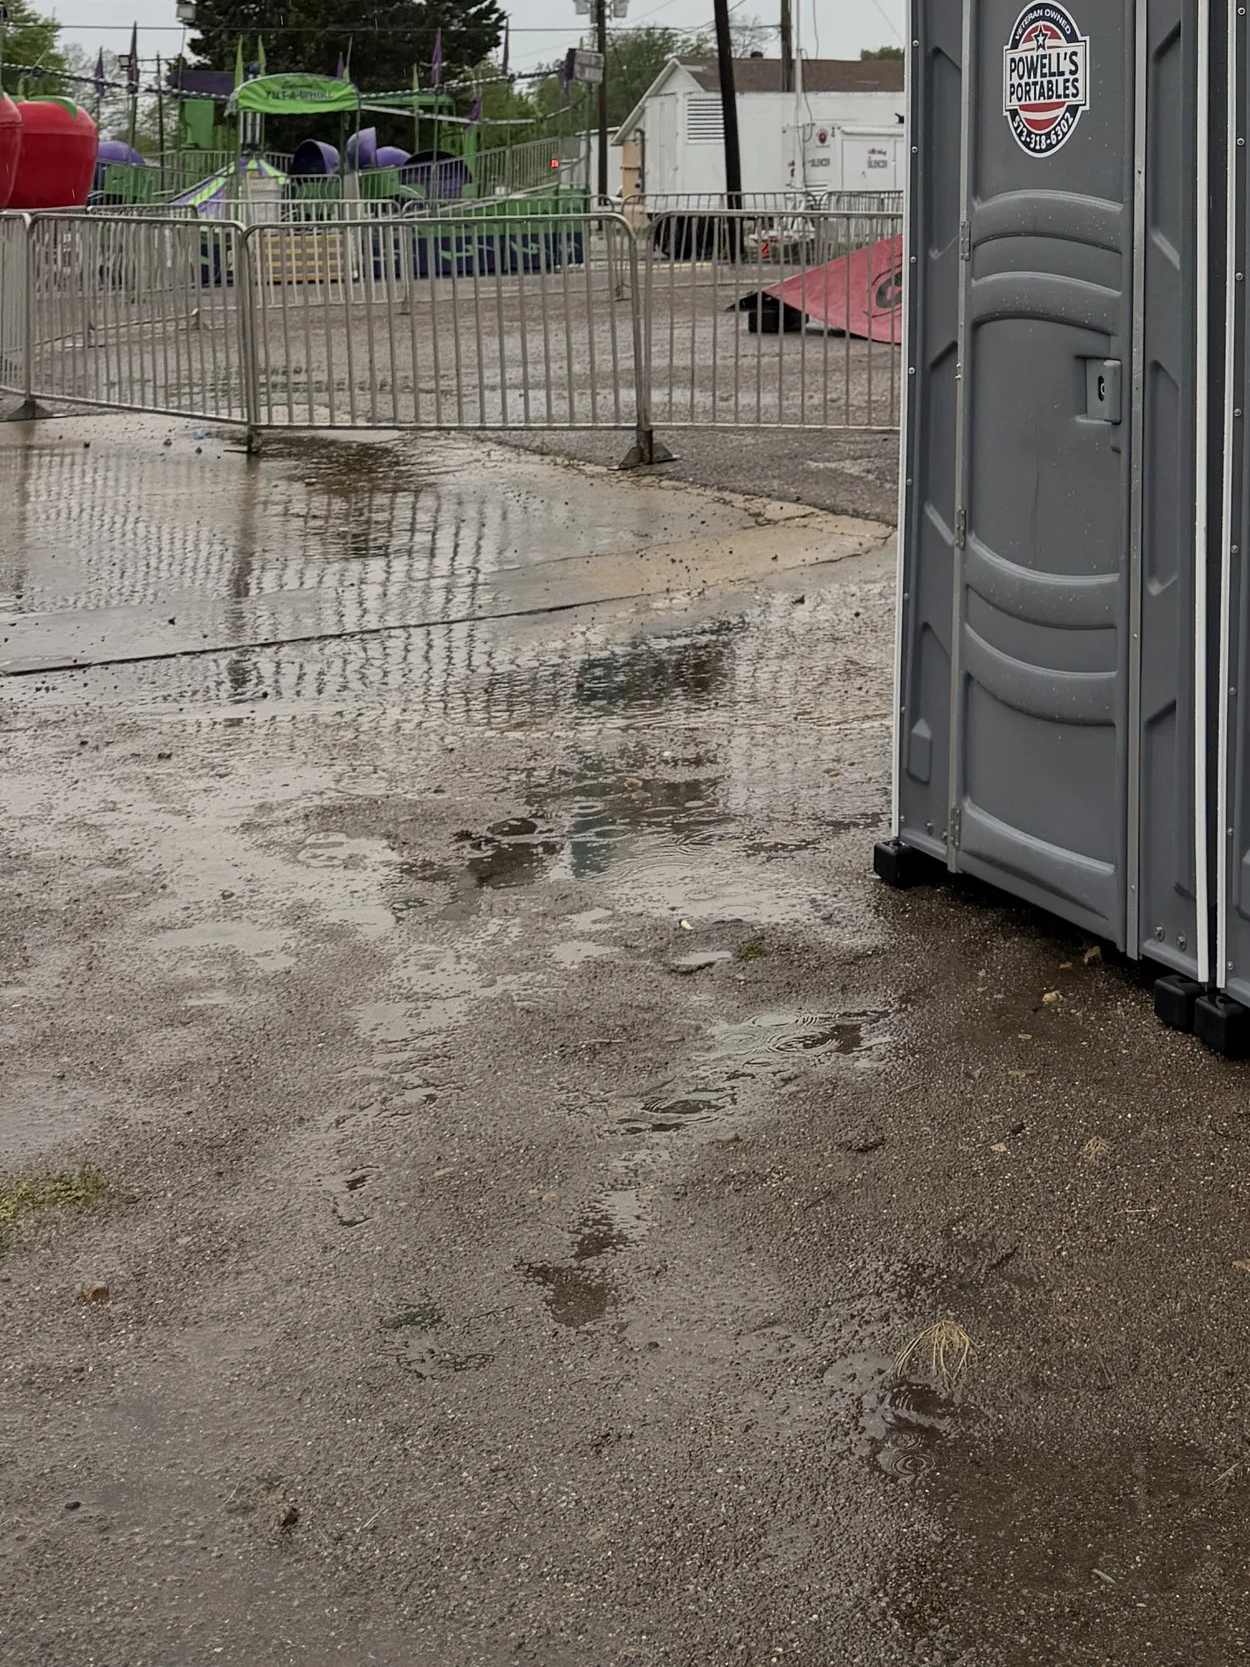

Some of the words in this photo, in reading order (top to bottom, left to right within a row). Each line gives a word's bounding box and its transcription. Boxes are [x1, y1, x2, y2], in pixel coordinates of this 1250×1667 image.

[1014, 9, 1043, 41] VETERAN
[1045, 9, 1071, 35] OWNED
[1009, 50, 1079, 82] POWELL'S
[1009, 77, 1079, 103] PORTABLES
[1012, 112, 1074, 150] 573-318-6302
